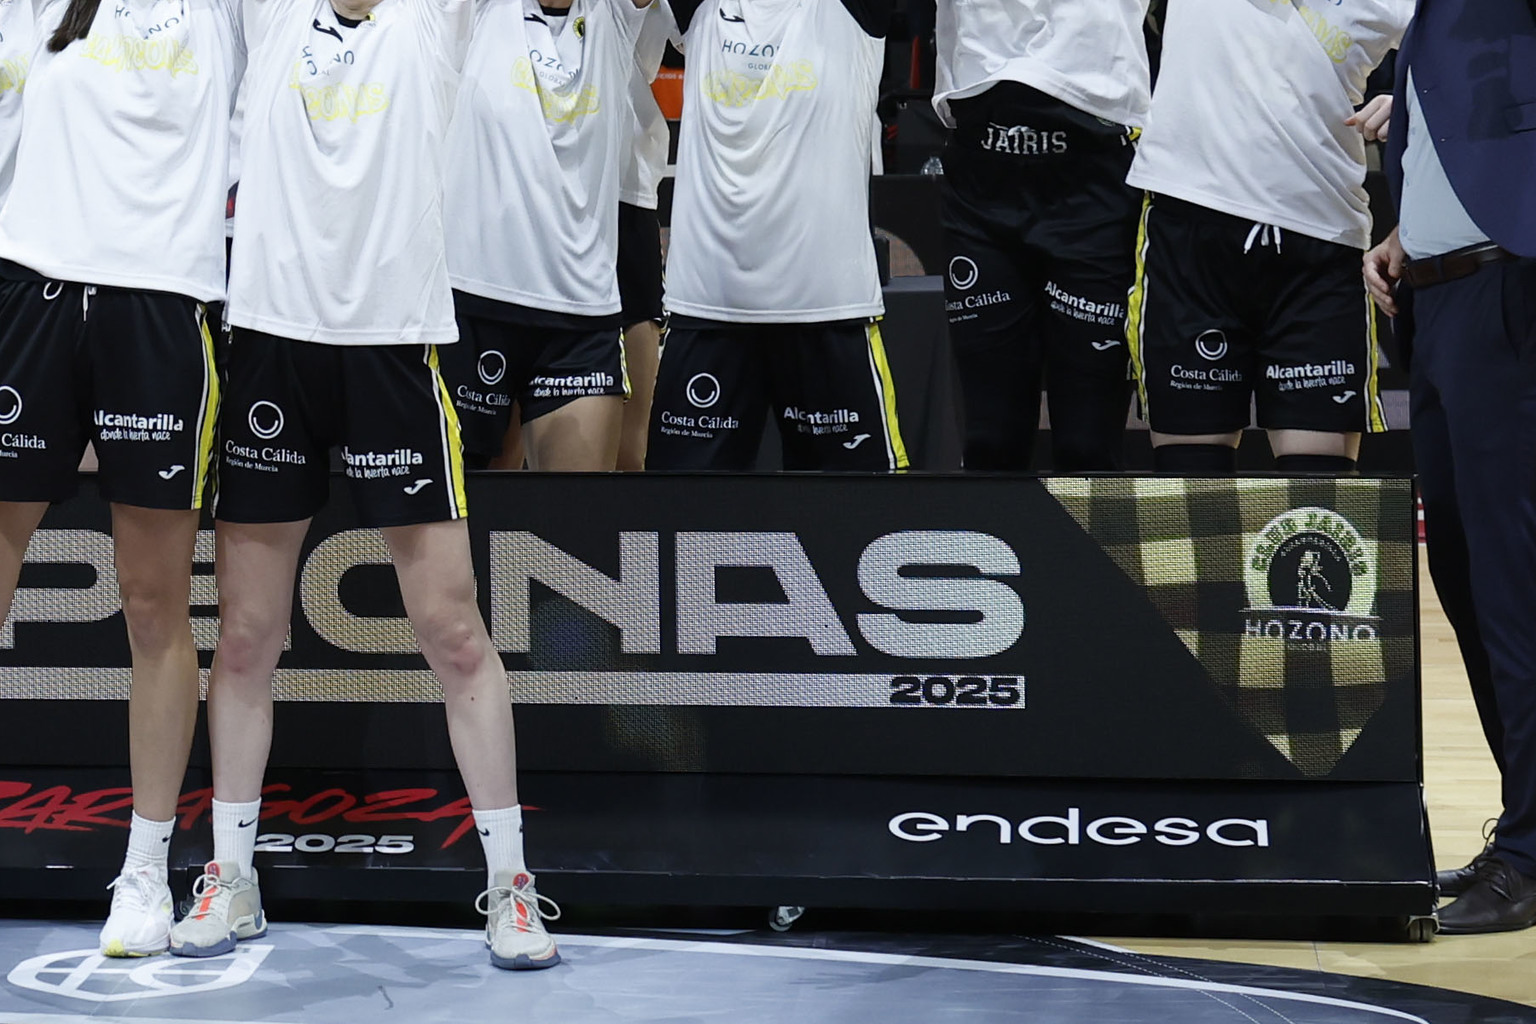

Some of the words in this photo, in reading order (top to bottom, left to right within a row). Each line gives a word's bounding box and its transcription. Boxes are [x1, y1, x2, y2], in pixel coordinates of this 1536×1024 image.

[722, 39, 780, 58] HOZO
[981, 127, 1068, 155] JAIRIS
[965, 290, 1011, 308] Cálida
[1170, 364, 1206, 380] Costa
[1266, 360, 1355, 379] Alcantarilla
[661, 411, 695, 427] Costa
[698, 416, 739, 429] Cálida
[784, 406, 859, 424] Alcntarilla
[1, 433, 47, 449] Cálida
[225, 440, 258, 459] Costa
[261, 447, 306, 465] Cálida
[341, 446, 423, 466] antarilla
[254, 462, 279, 473] Murcia
[1246, 619, 1376, 641] HOZONO
[890, 676, 1021, 706] 2025
[888, 808, 1270, 847] endesa
[254, 833, 415, 854] 2025
